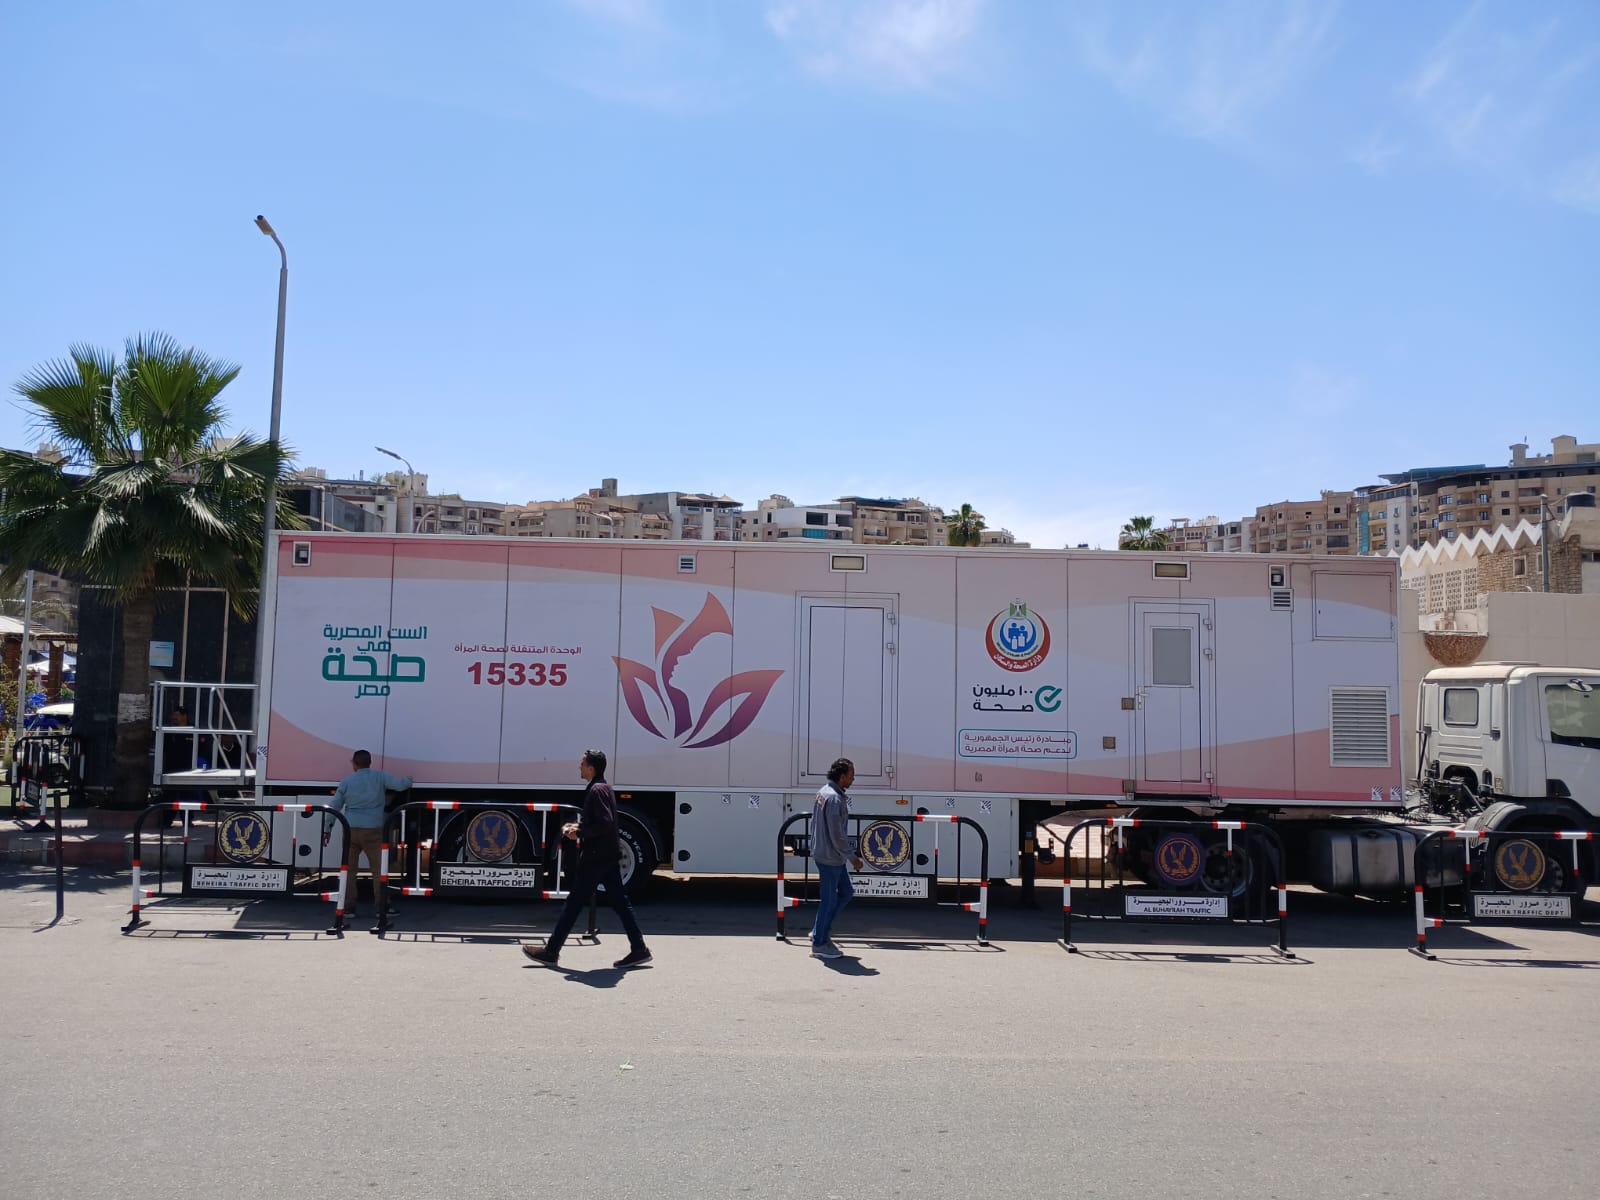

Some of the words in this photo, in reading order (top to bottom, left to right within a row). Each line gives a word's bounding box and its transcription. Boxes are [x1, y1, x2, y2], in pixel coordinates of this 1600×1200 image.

[323, 623, 382, 641] المصرية
[386, 624, 428, 640] الست
[357, 640, 391, 655] هي
[454, 642, 480, 654] المرأة
[481, 643, 509, 653] لصحة
[510, 644, 549, 654] المتنقلة
[550, 645, 582, 655] الوحدة
[322, 646, 426, 683] صحة
[467, 661, 568, 687] 15335
[354, 683, 391, 699] مصر
[972, 684, 1016, 699] مليون
[972, 699, 1034, 713] صحة
[964, 733, 1010, 743] الجمهورية
[1010, 734, 1035, 744] رئيس
[1036, 734, 1072, 744] مبادرة
[964, 744, 997, 755] المصرية
[998, 744, 1020, 754] المرأة
[1020, 744, 1042, 754] صحة
[1043, 746, 1072, 755] لدعم
[197, 870, 232, 881] البحيرة
[236, 872, 257, 881] مرور
[442, 868, 486, 878] البحيرة
[486, 870, 513, 879] مرور
[441, 878, 475, 886] BEHEIRA
[477, 879, 510, 887] TRAFFIC
[877, 880, 898, 889] مرور
[1133, 896, 1174, 906] البحيرة
[1480, 897, 1515, 909] البحيرة
[1519, 900, 1540, 909] مرور
